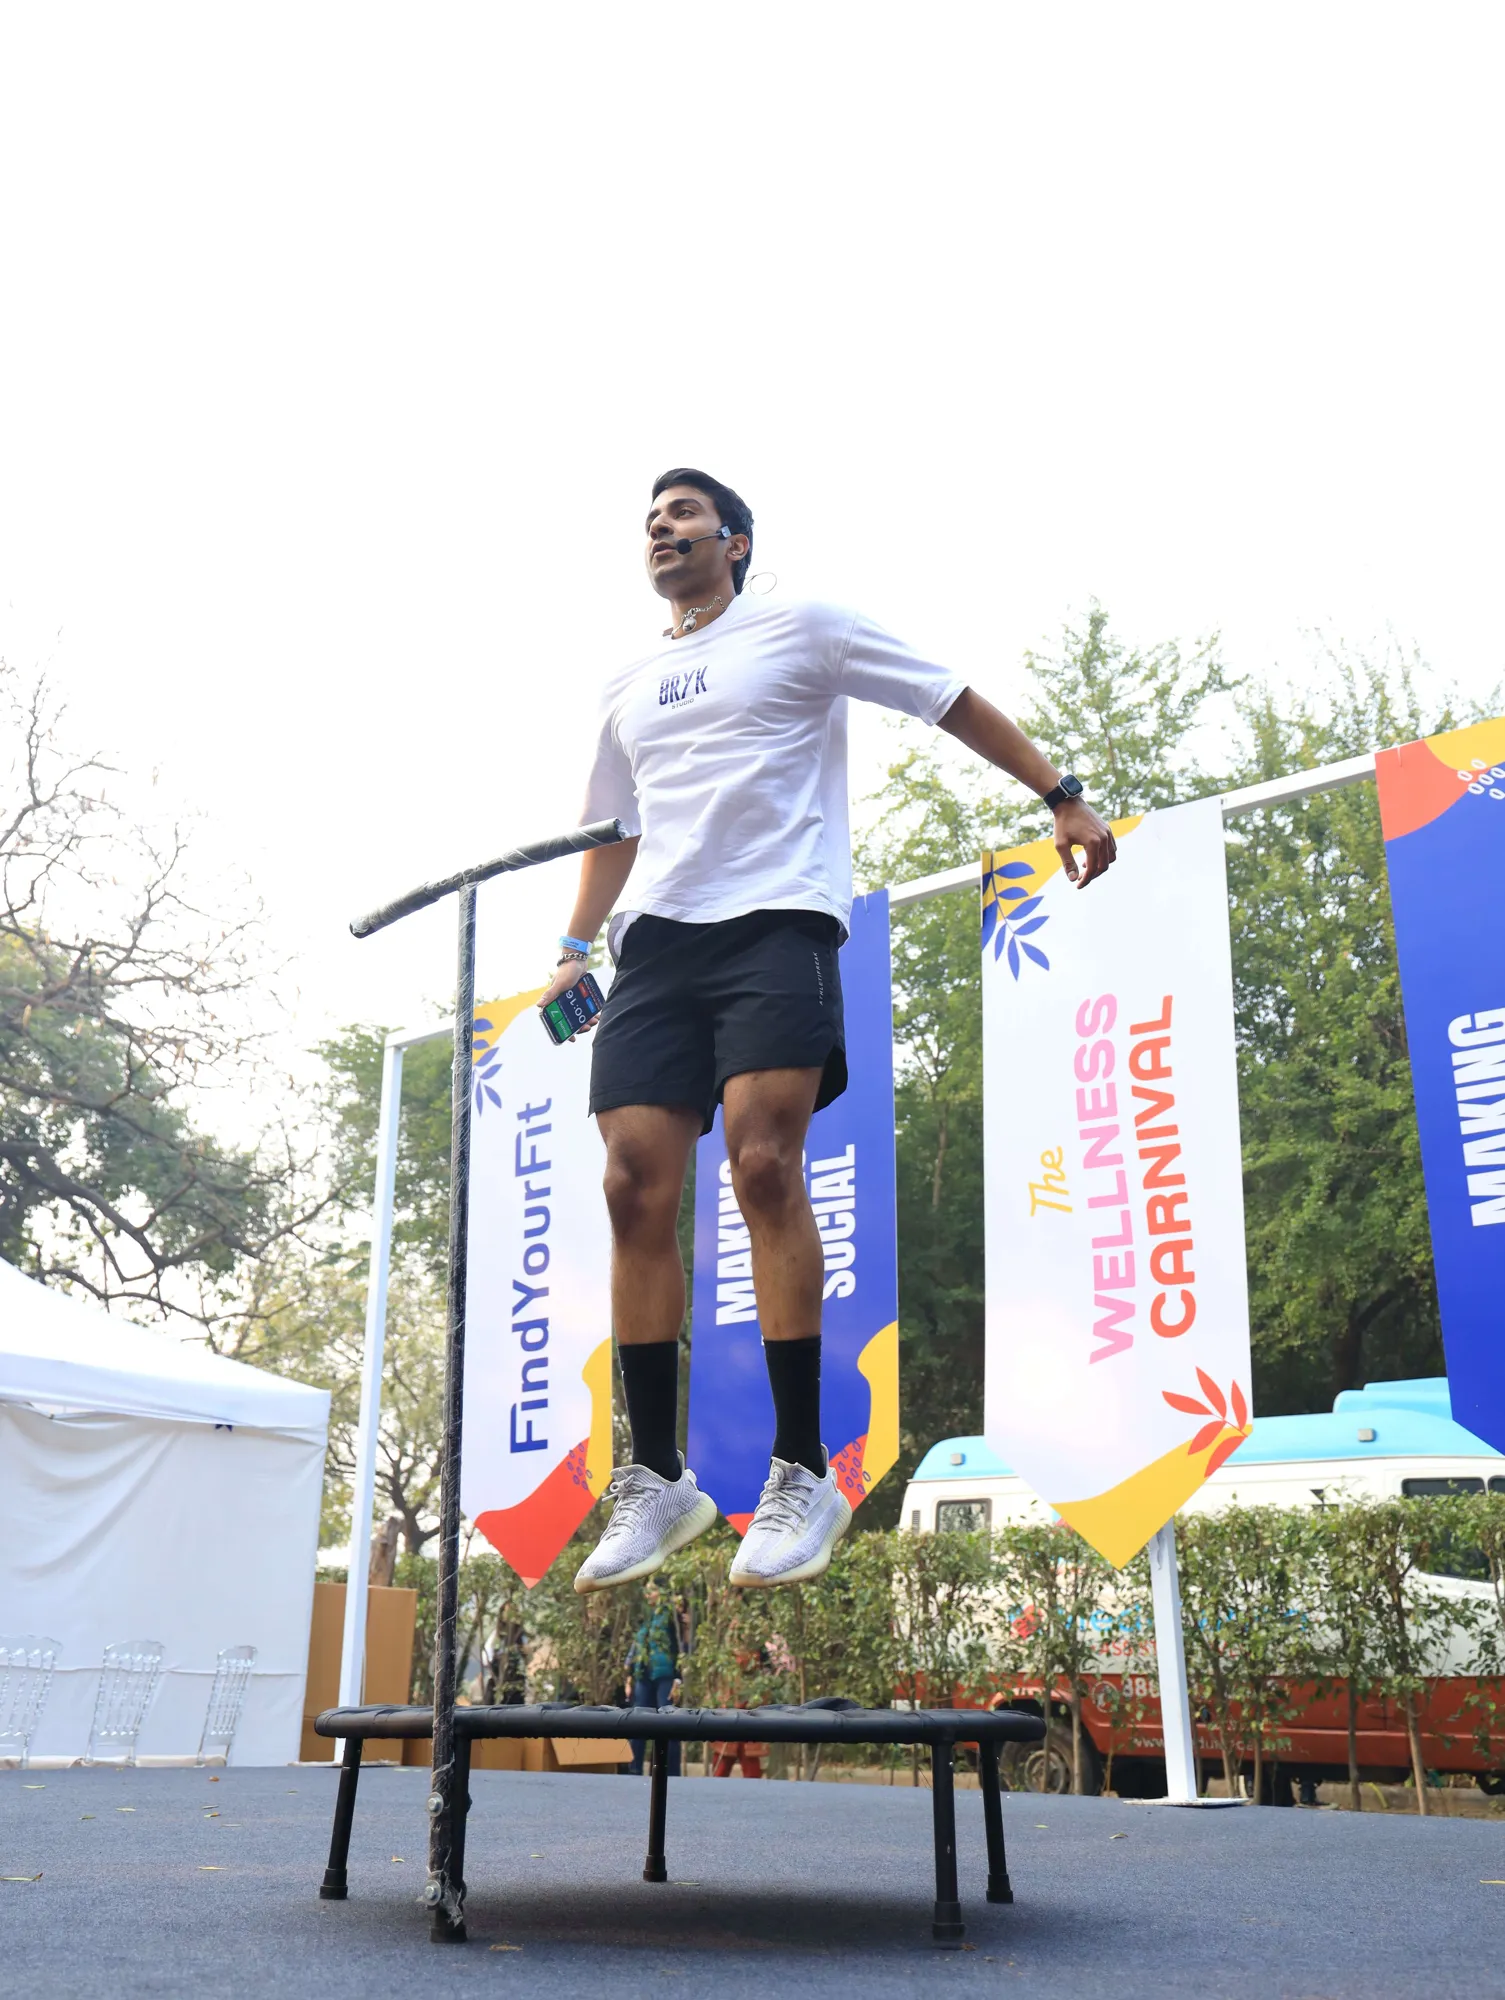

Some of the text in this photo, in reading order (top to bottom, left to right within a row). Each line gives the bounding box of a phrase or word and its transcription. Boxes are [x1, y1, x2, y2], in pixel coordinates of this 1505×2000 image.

[671, 698, 694, 710] STUDIO
[565, 989, 587, 1024] 00:16
[1028, 1145, 1073, 1217] The
[1073, 993, 1137, 1365] WELLNESS
[1128, 994, 1197, 1339] CARNIVAL
[510, 1097, 552, 1454] FindYourFit
